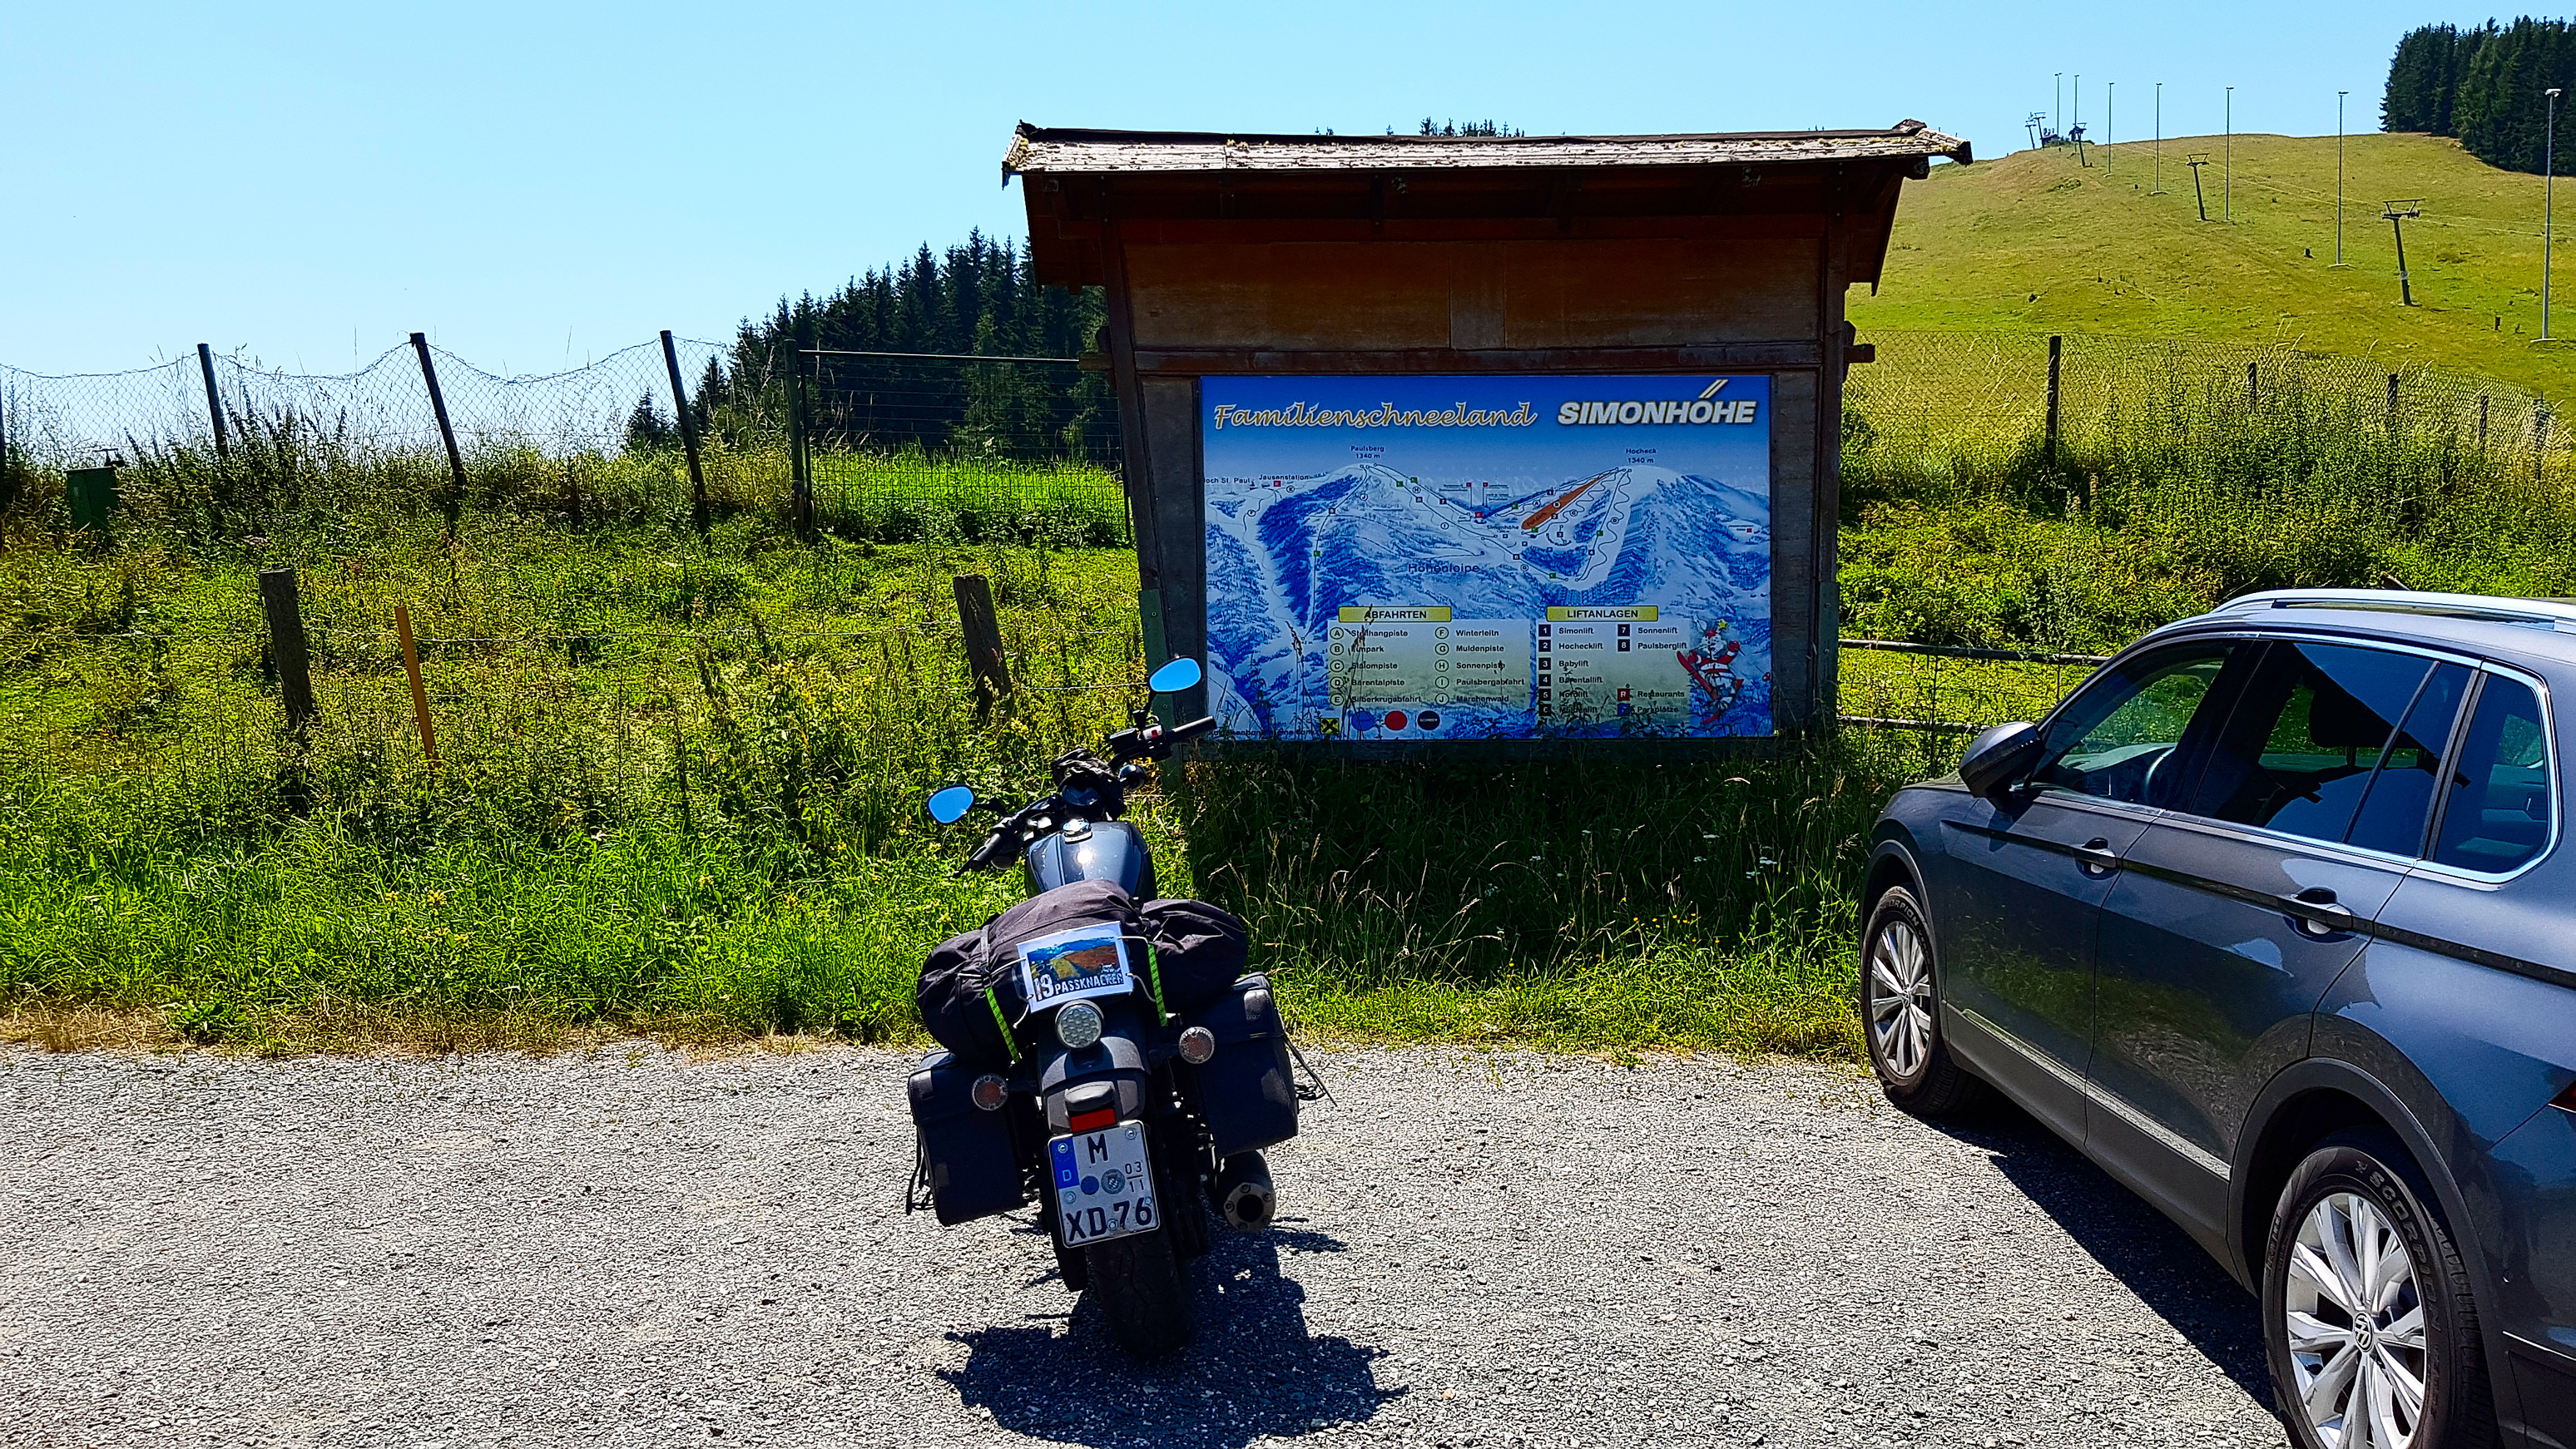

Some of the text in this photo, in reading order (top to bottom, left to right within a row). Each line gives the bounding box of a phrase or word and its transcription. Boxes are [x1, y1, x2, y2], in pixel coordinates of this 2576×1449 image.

[1214, 379, 1756, 429] Familienschneeland SIMONHÖHE
[1365, 610, 1427, 620] ABFAHRTEN
[1567, 610, 1638, 618] LIFTANLAGEN
[1637, 642, 1687, 650] Paulsberglift
[1558, 660, 1589, 668] Babylift
[1033, 972, 1124, 1001] 19 PASSKNACKER
[1087, 1134, 1108, 1164] M
[1125, 1161, 1143, 1175] 03
[1062, 1169, 1072, 1182] D
[1129, 1179, 1144, 1193] 11
[1066, 1197, 1152, 1242] XD 76
